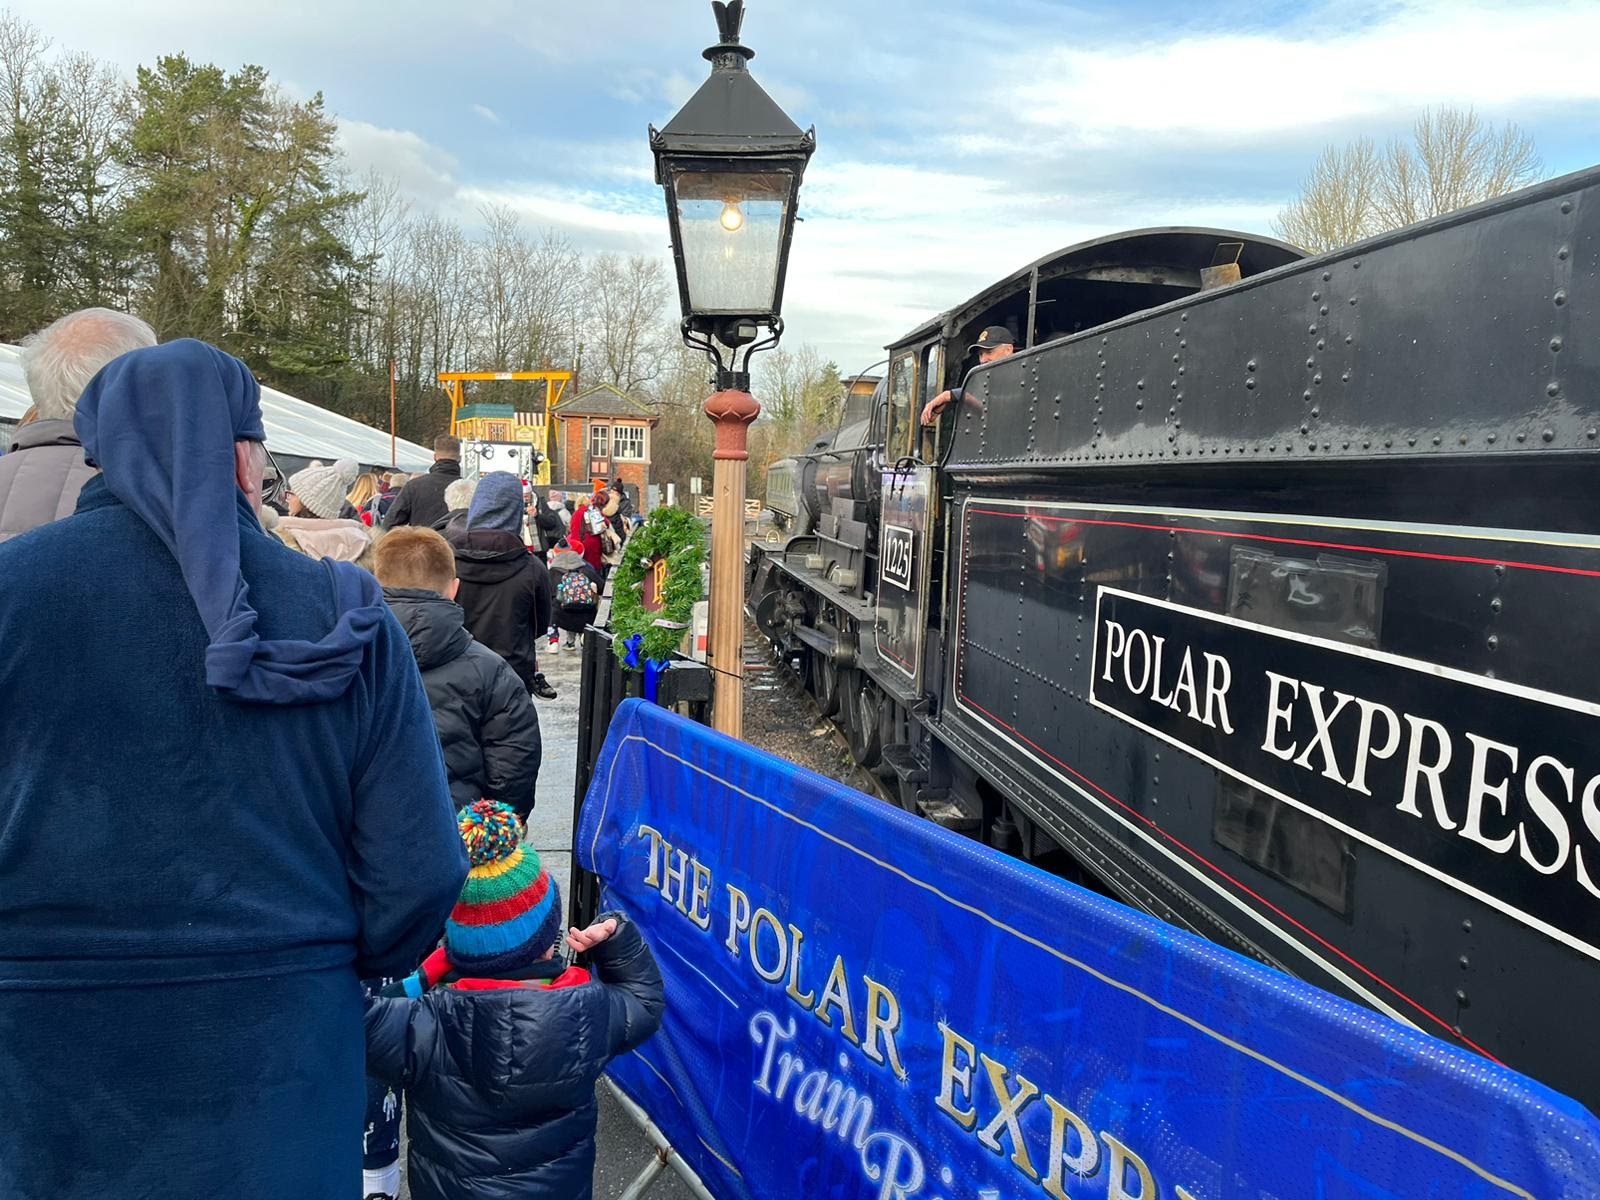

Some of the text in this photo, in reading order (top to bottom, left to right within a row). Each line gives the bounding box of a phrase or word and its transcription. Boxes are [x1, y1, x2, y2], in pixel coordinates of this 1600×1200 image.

[885, 536, 909, 578] 1225
[1102, 619, 1235, 735] POLAR
[637, 824, 1198, 1200] THE POLAR EXPR
[749, 1010, 874, 1150] Train
